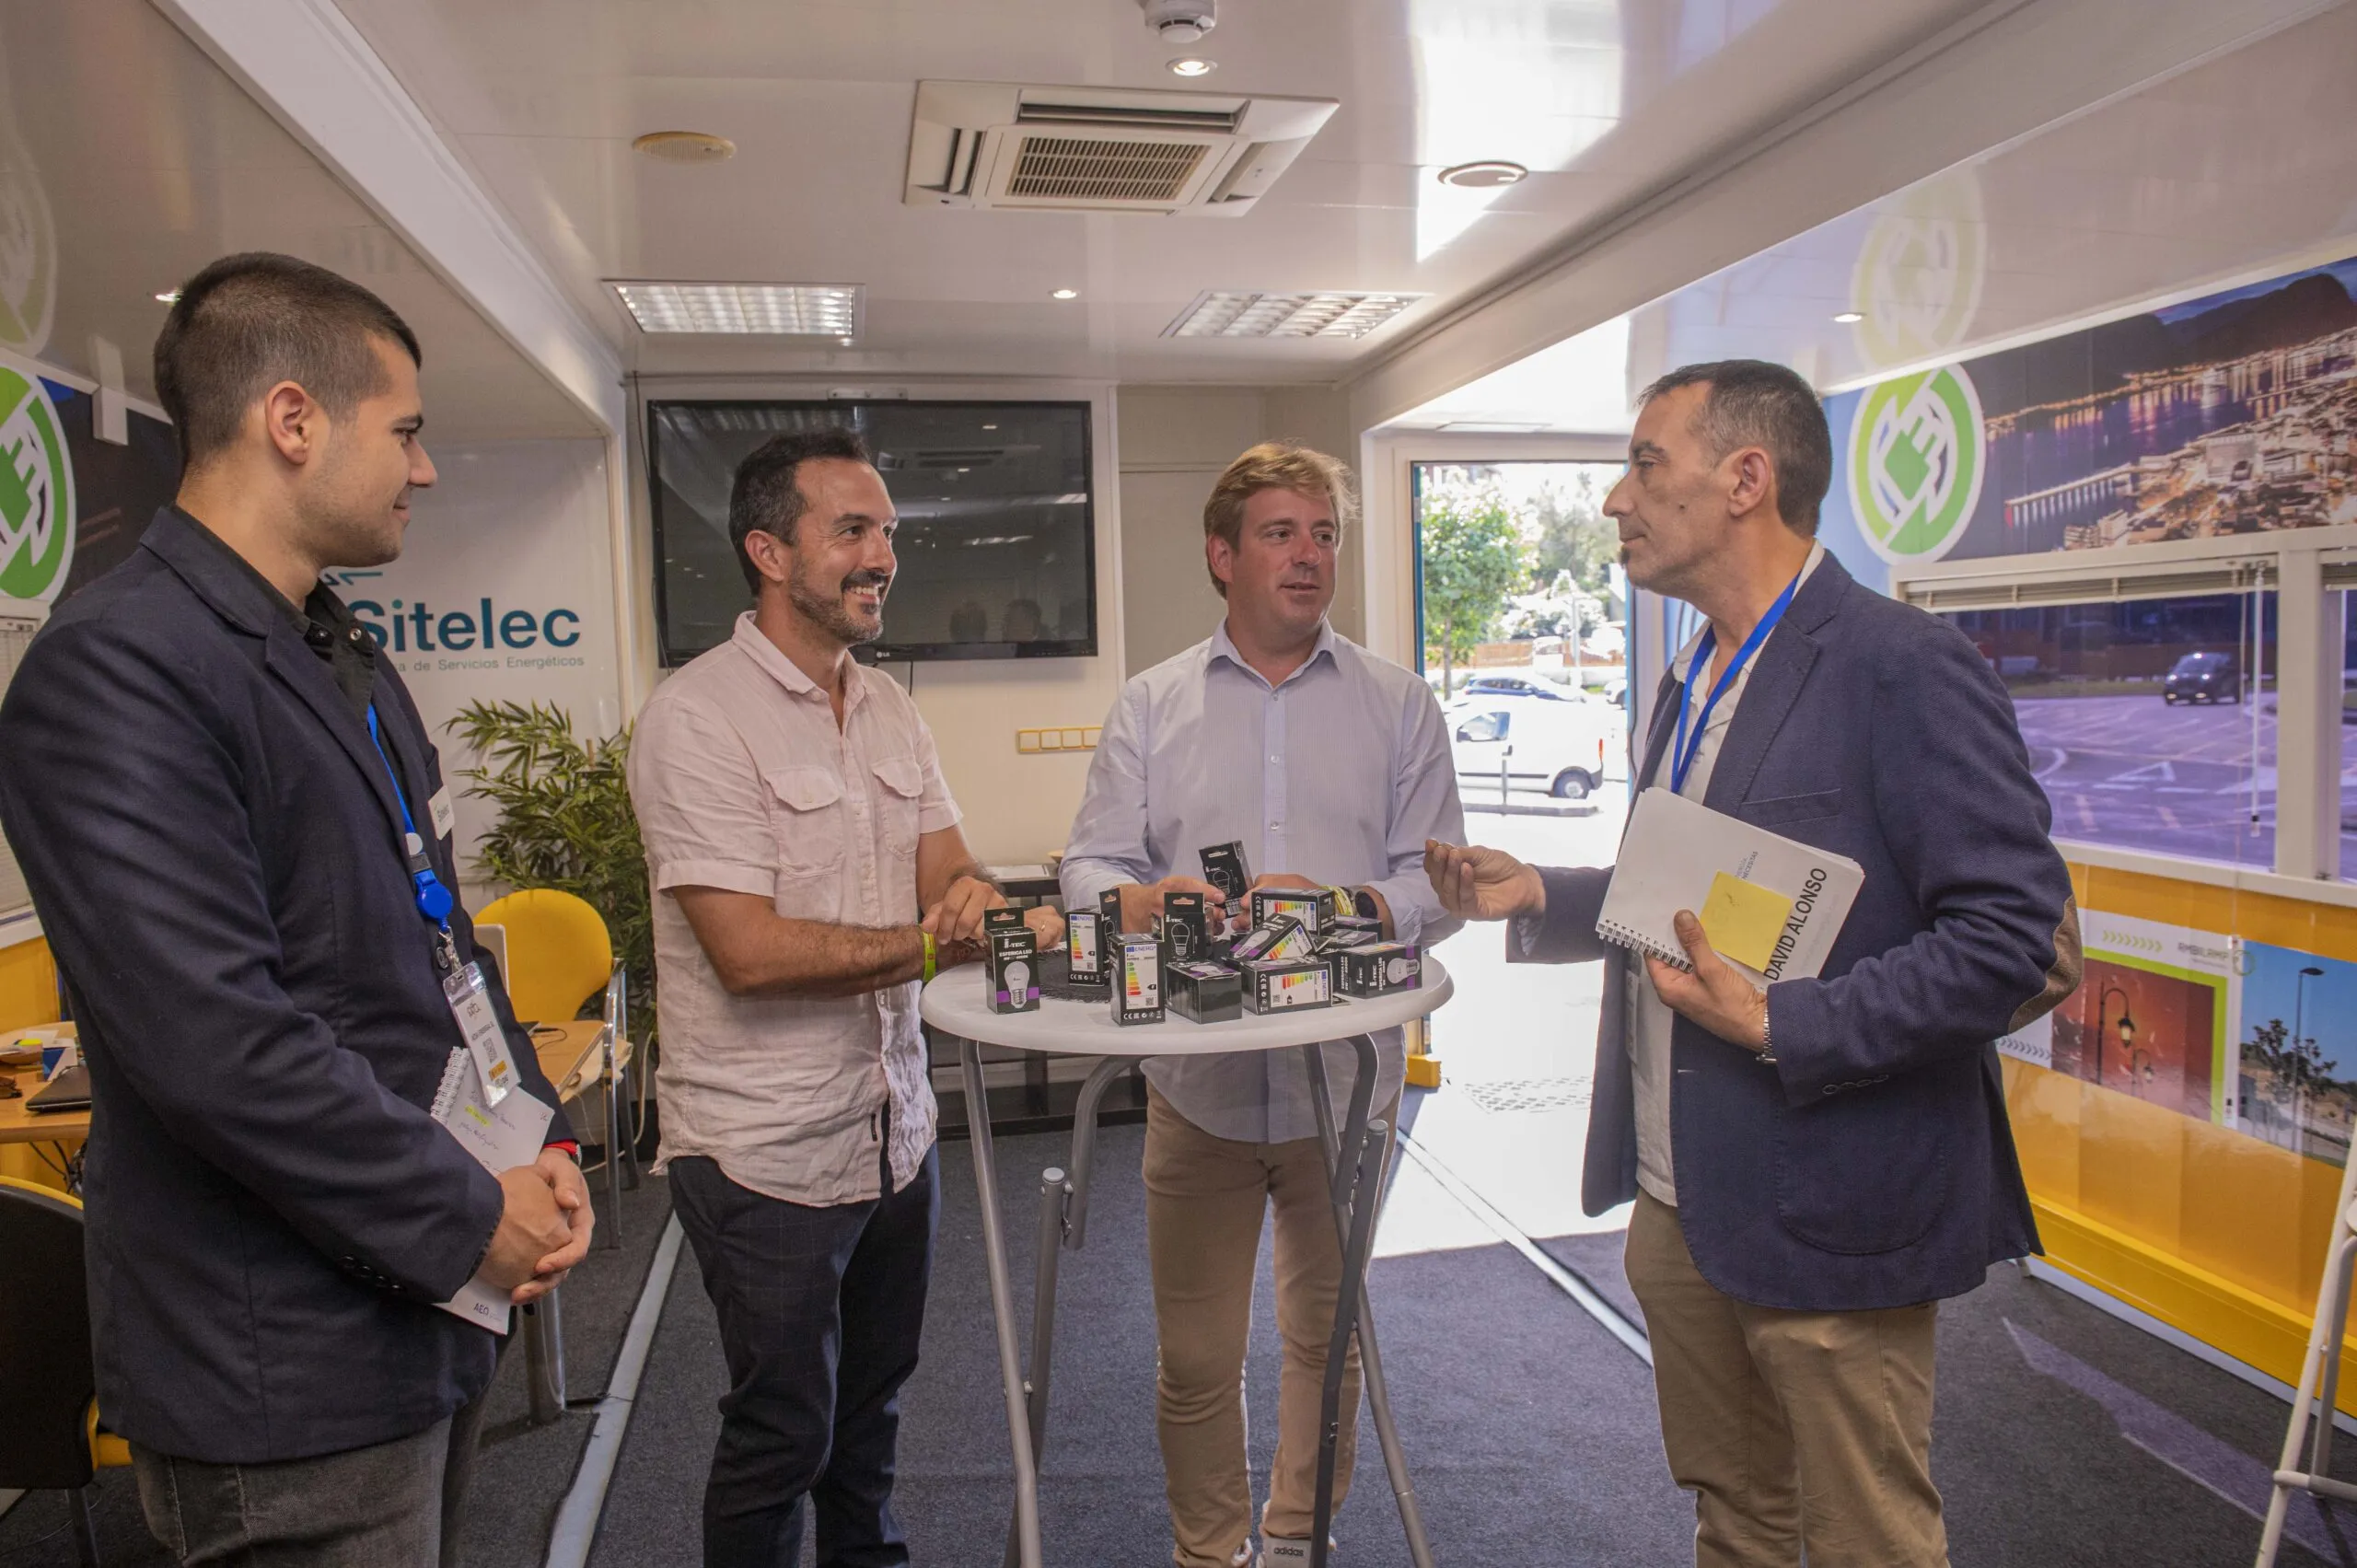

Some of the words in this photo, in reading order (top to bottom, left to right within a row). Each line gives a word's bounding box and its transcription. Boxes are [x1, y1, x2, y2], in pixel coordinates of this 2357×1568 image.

[346, 598, 581, 653] Sitelec
[413, 659, 431, 671] de
[438, 658, 499, 670] Servicios
[506, 656, 585, 670] Energéticos
[1763, 928, 1795, 981] DAVID
[1794, 867, 1828, 936] ALONSO
[1273, 1546, 1304, 1557] adidas
